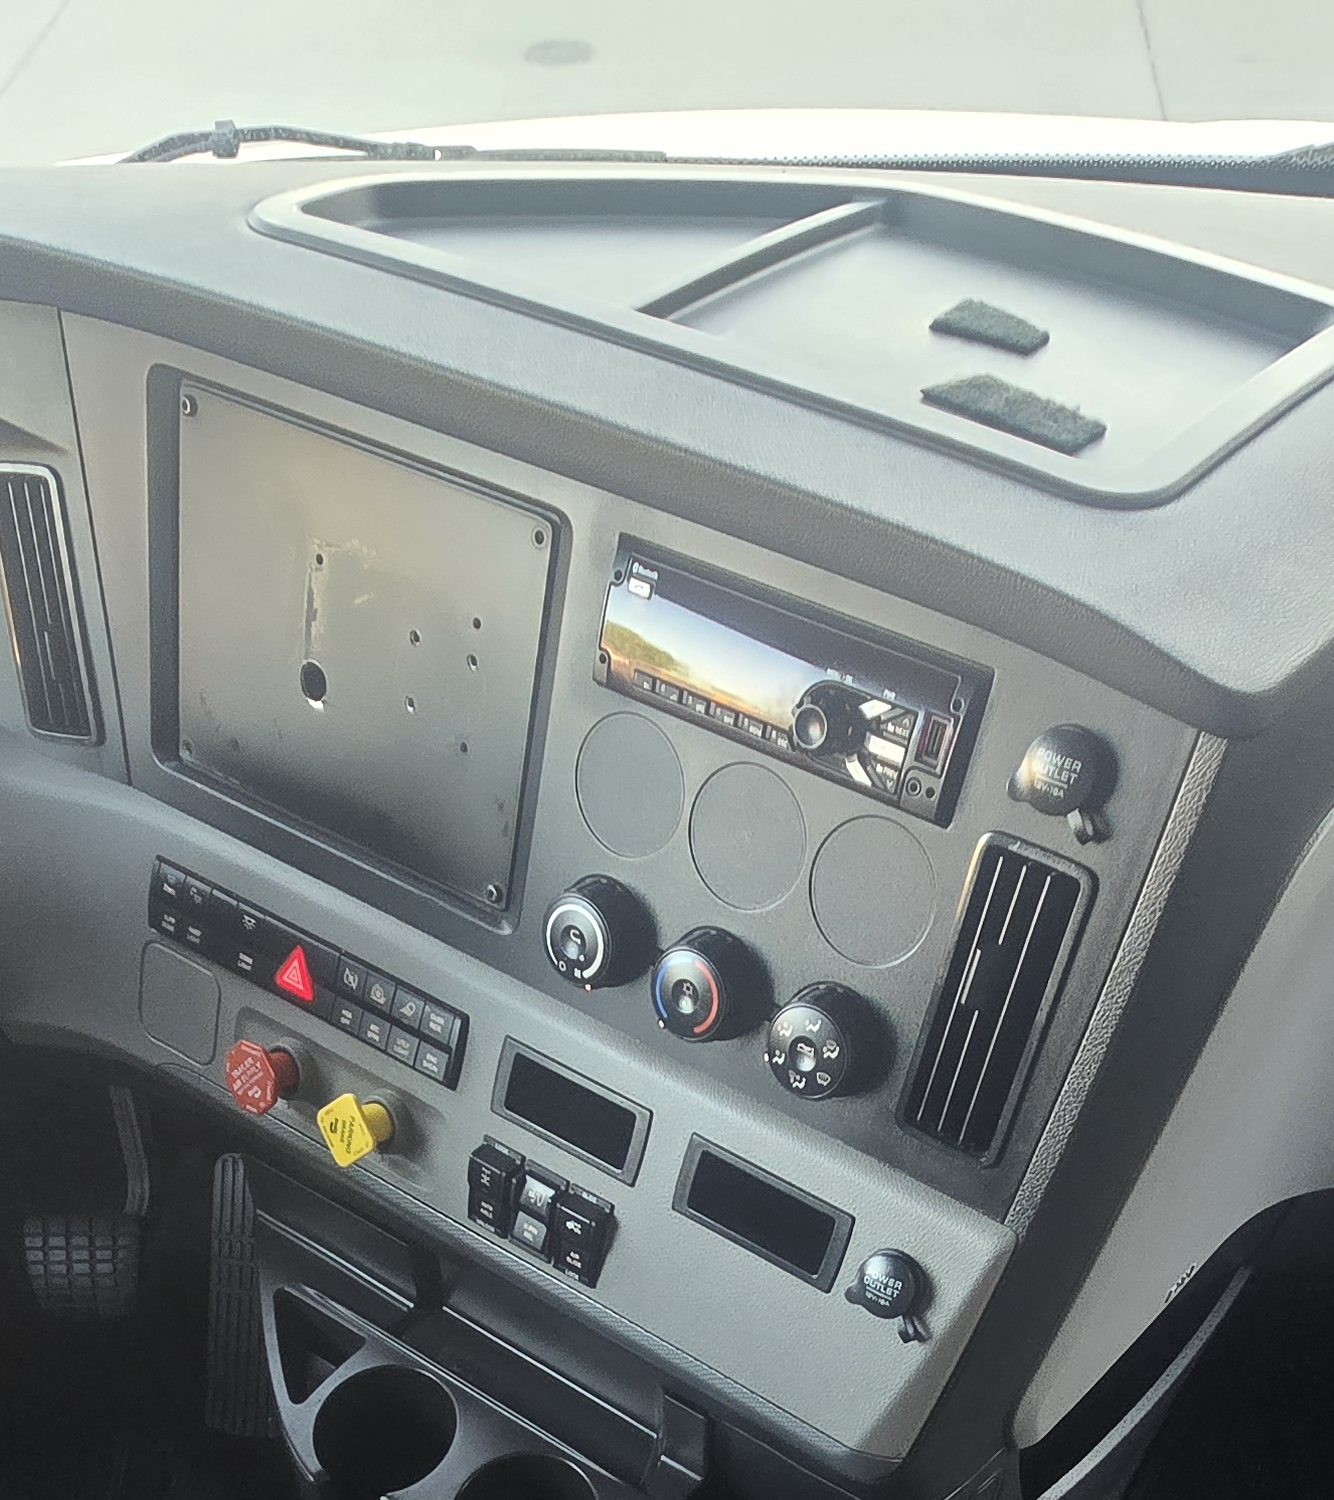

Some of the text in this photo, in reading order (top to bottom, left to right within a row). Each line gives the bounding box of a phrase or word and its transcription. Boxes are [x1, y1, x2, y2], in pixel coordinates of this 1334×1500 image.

[1033, 760, 1078, 785] UTLET
[1036, 747, 1082, 773] POWER
[345, 1114, 356, 1155] PARKING
[863, 1275, 900, 1298] OUTLET
[866, 1265, 903, 1290] OWER
